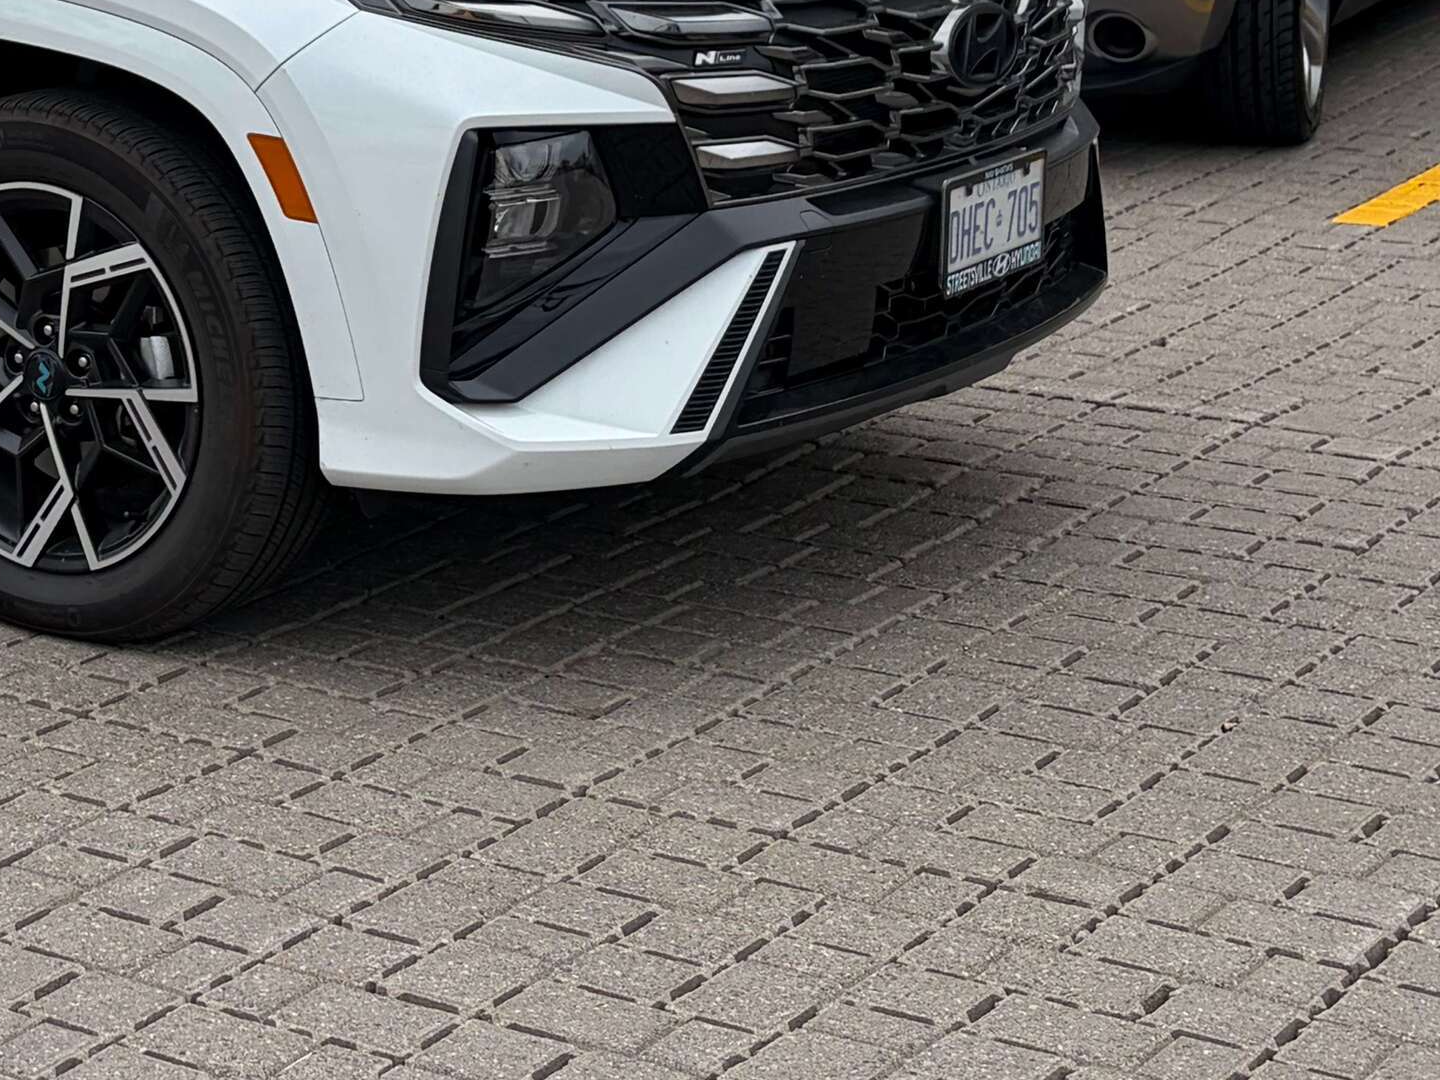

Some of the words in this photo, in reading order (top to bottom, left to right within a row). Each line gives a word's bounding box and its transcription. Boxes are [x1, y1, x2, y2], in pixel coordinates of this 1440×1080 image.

[695, 50, 717, 66] N
[949, 198, 996, 265] DHEC
[1006, 181, 1041, 243] 705
[946, 260, 993, 295] STREETSVILLE
[1011, 241, 1041, 270] HYUNDAI
